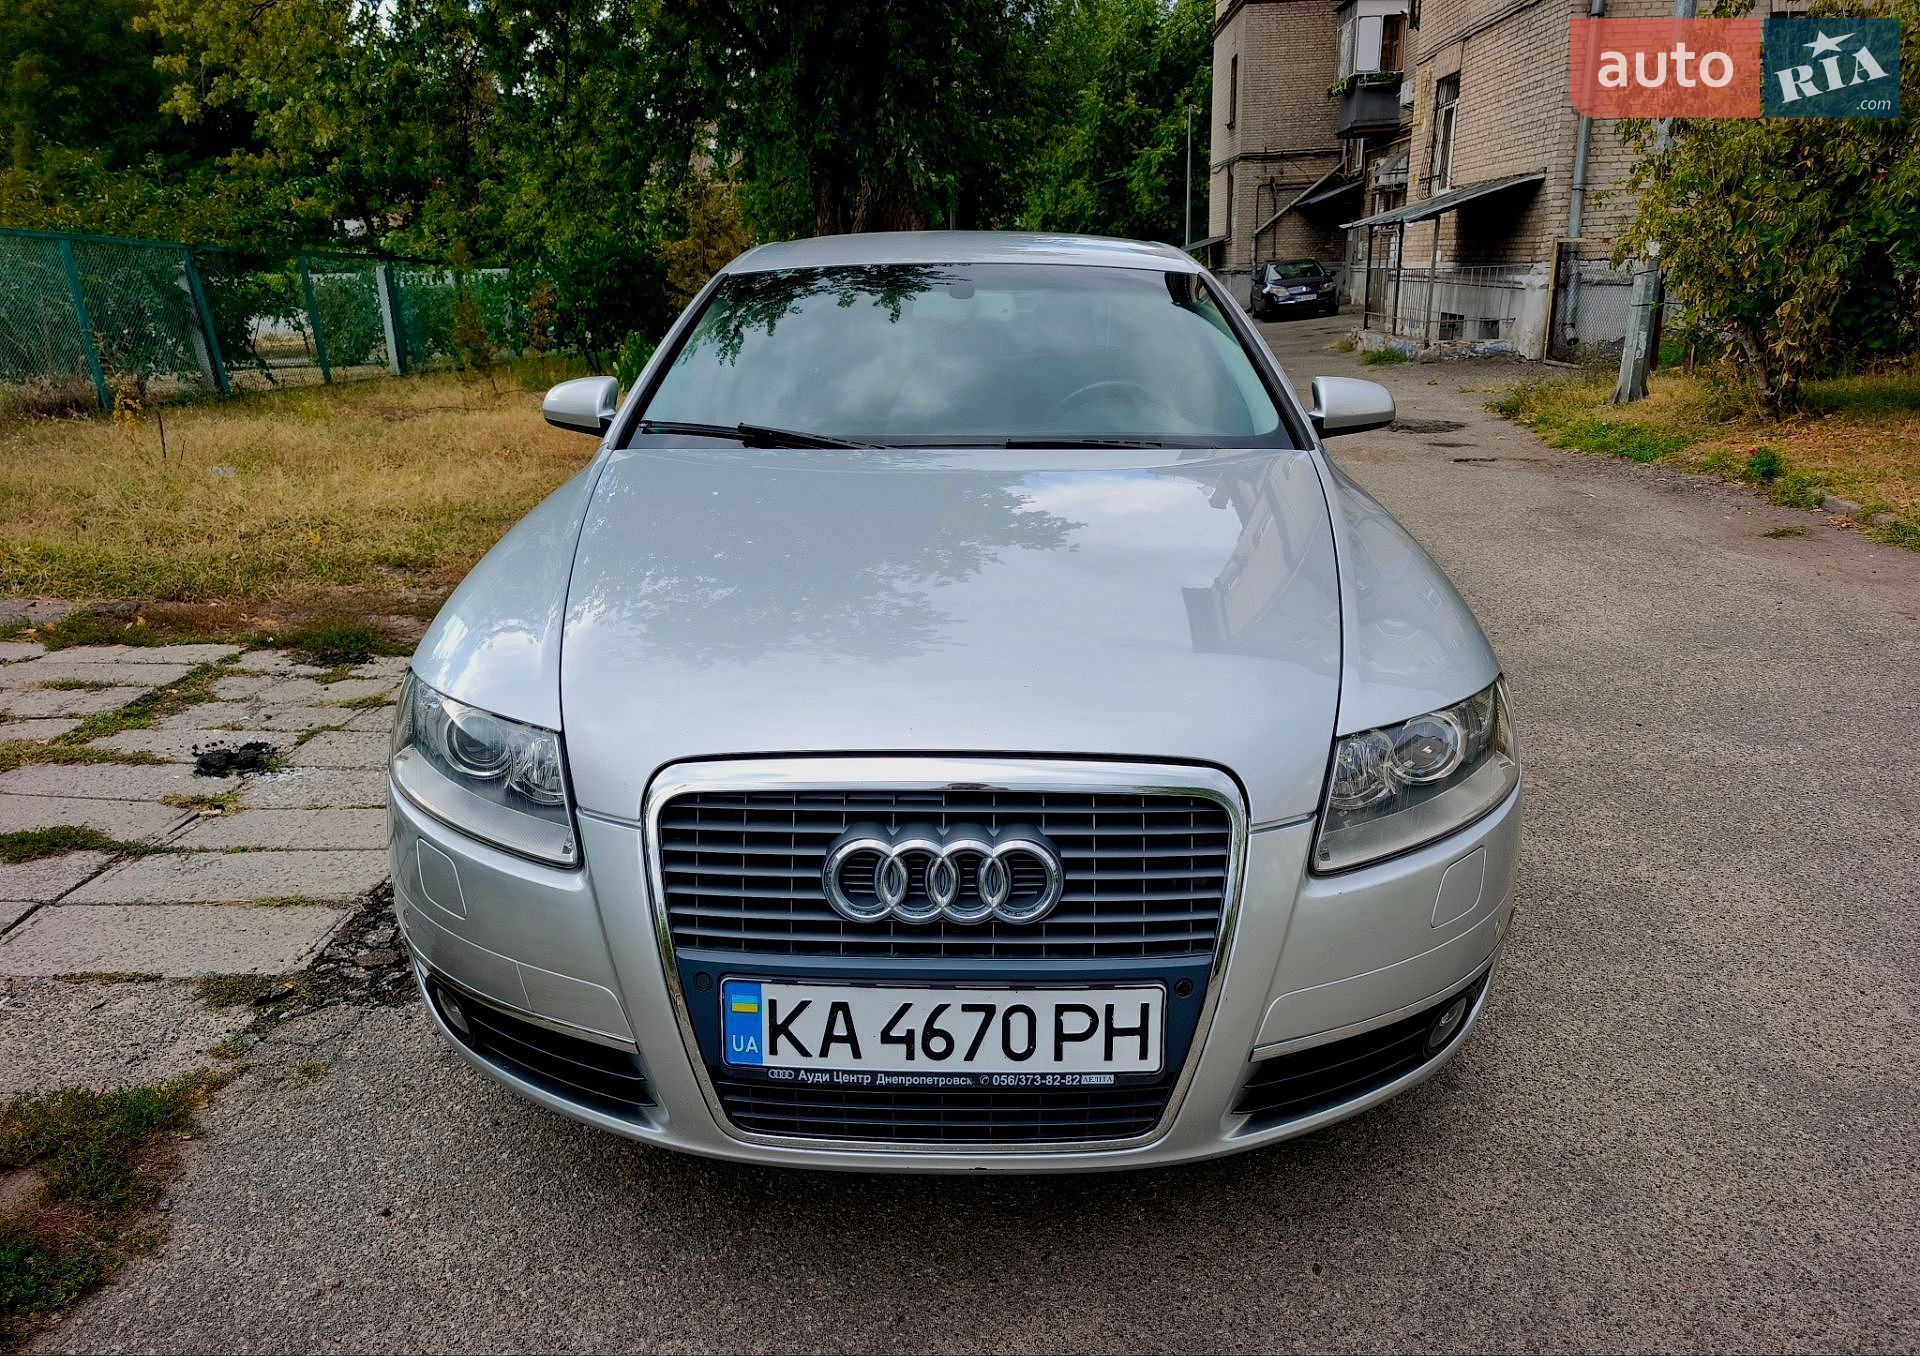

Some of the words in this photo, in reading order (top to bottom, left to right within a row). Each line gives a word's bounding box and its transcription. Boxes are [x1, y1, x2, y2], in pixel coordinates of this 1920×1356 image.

[767, 998, 862, 1059] KA
[880, 1002, 1037, 1062] 4670
[1053, 1002, 1150, 1062] PH
[731, 1034, 759, 1053] UA
[798, 1069, 830, 1084] Ауди
[833, 1071, 872, 1086] Центр
[992, 1074, 1080, 1086] 056/373-82-82
